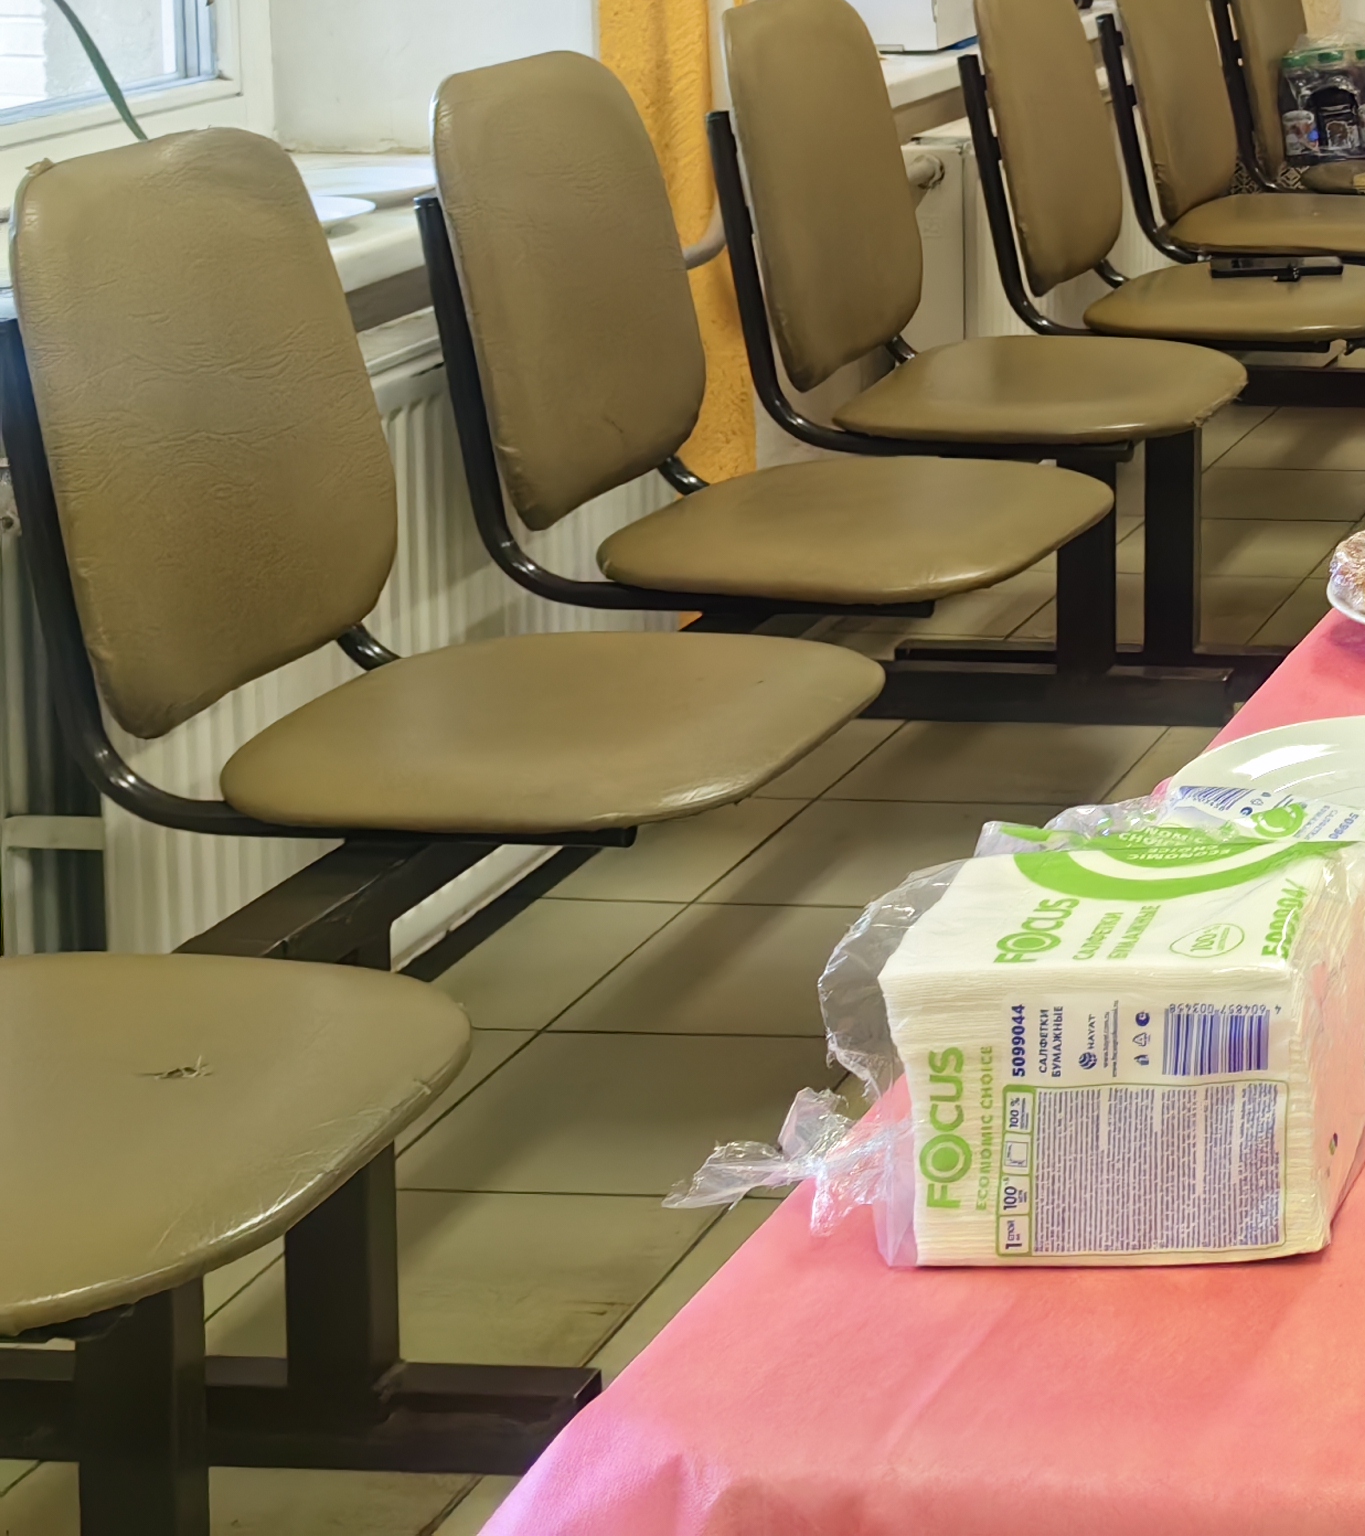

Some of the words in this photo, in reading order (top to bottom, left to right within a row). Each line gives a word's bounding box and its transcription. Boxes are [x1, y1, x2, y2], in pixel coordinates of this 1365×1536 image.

[993, 898, 1080, 964] FOCUS
[1011, 1004, 1026, 1078] 5099044
[1039, 1008, 1050, 1074] САЛФЕТКИ
[1051, 1005, 1064, 1078] БУМАЖНЫЕ
[1087, 1013, 1098, 1050] HAYAT
[980, 1045, 993, 1110] CHOICE
[919, 1046, 973, 1210] FOCUS
[976, 1114, 993, 1211] ECONOMIC
